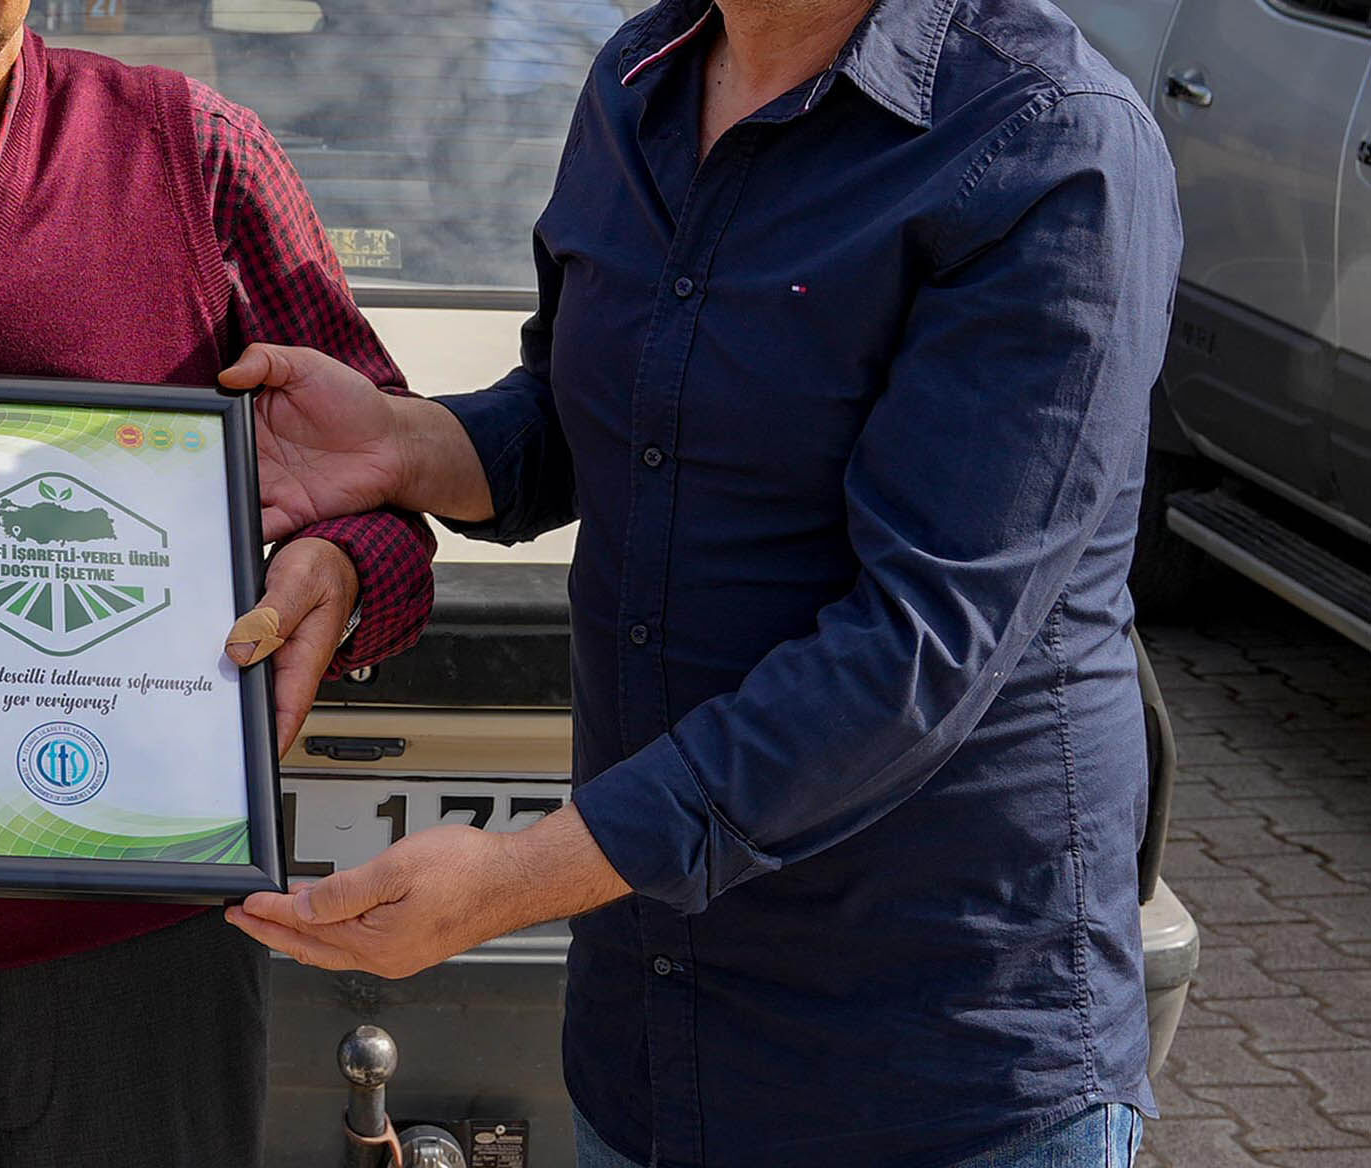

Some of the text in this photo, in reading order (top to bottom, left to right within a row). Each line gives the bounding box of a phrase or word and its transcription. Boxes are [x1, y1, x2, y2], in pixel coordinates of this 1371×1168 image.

[12, 544, 125, 565] İŞARETLİ-YEREL
[128, 550, 171, 567] ÜRÜN
[0, 563, 116, 582] DOSTU İŞLETME
[50, 668, 122, 689] tatlarına
[127, 672, 214, 697] soframızda
[2, 692, 118, 716] yer veriyoruz!
